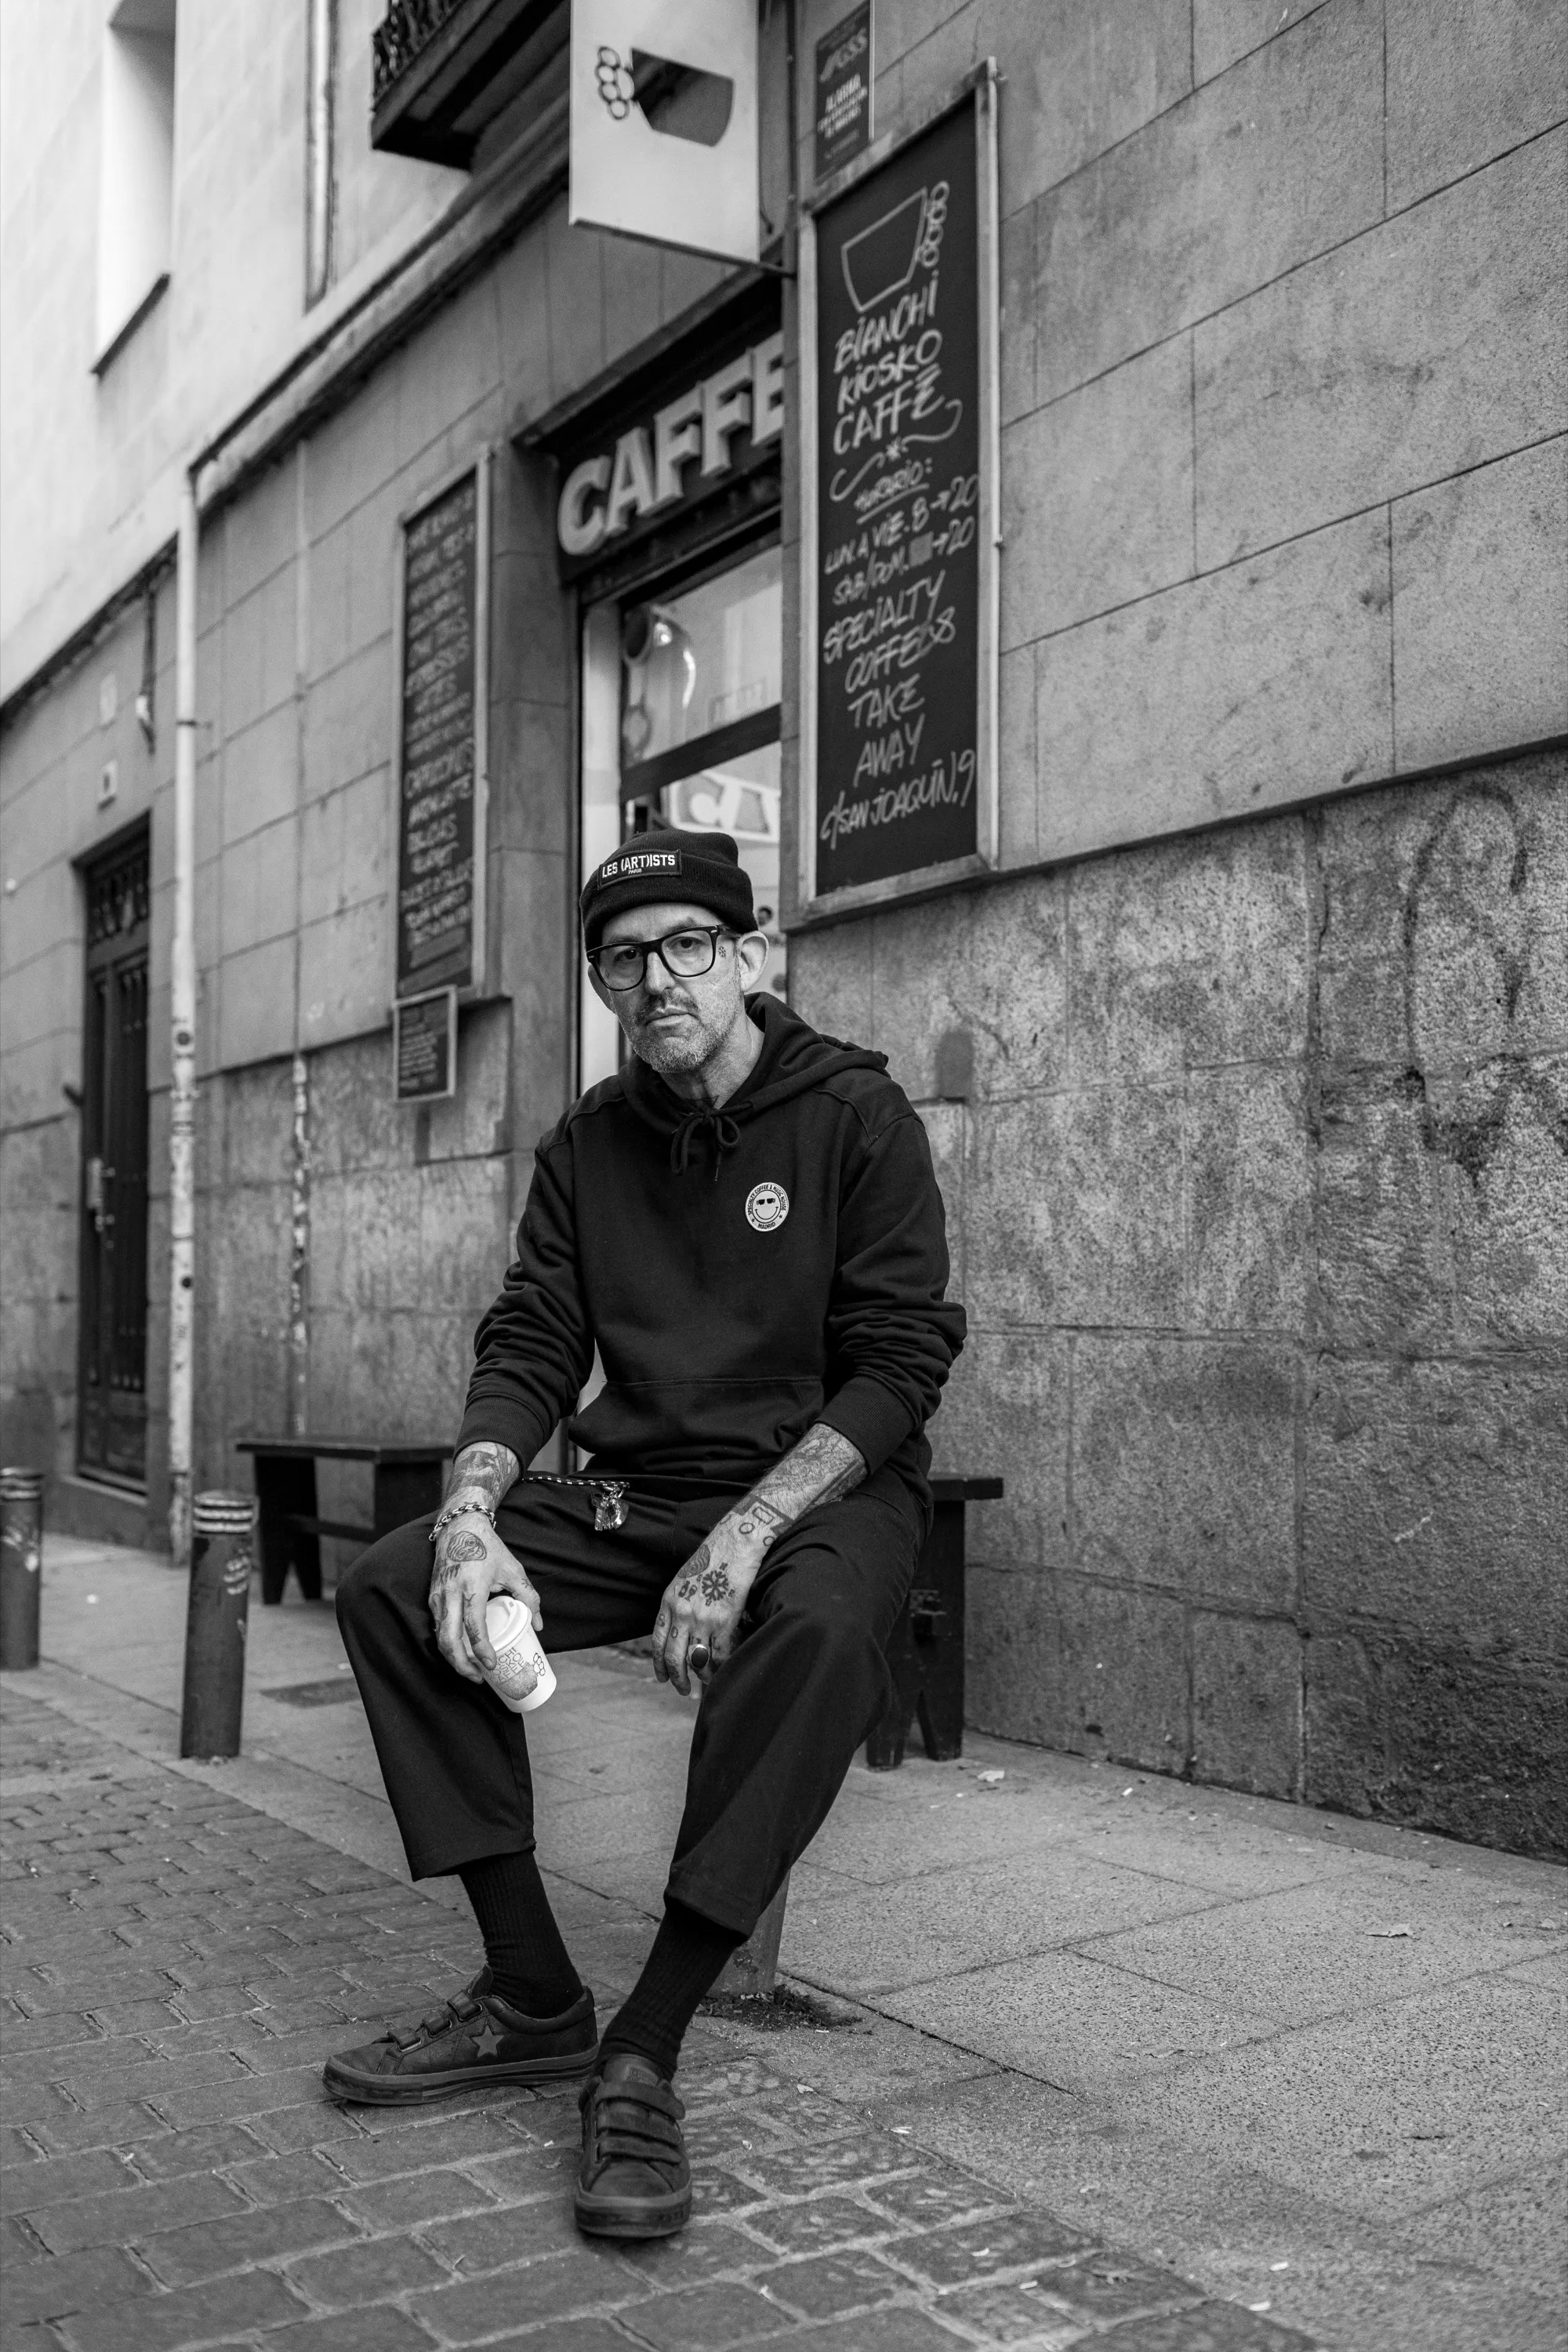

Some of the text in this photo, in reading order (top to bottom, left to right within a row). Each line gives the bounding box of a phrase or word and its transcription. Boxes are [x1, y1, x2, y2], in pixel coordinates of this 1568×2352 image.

[837, 329, 942, 414] KIOSKO
[824, 569, 946, 664] SPECIALTY
[848, 673, 926, 728] TAKE
[853, 712, 926, 788] AWAY
[602, 854, 676, 878] LES (ART)ISTS
[754, 1184, 769, 1194] COFFEE
